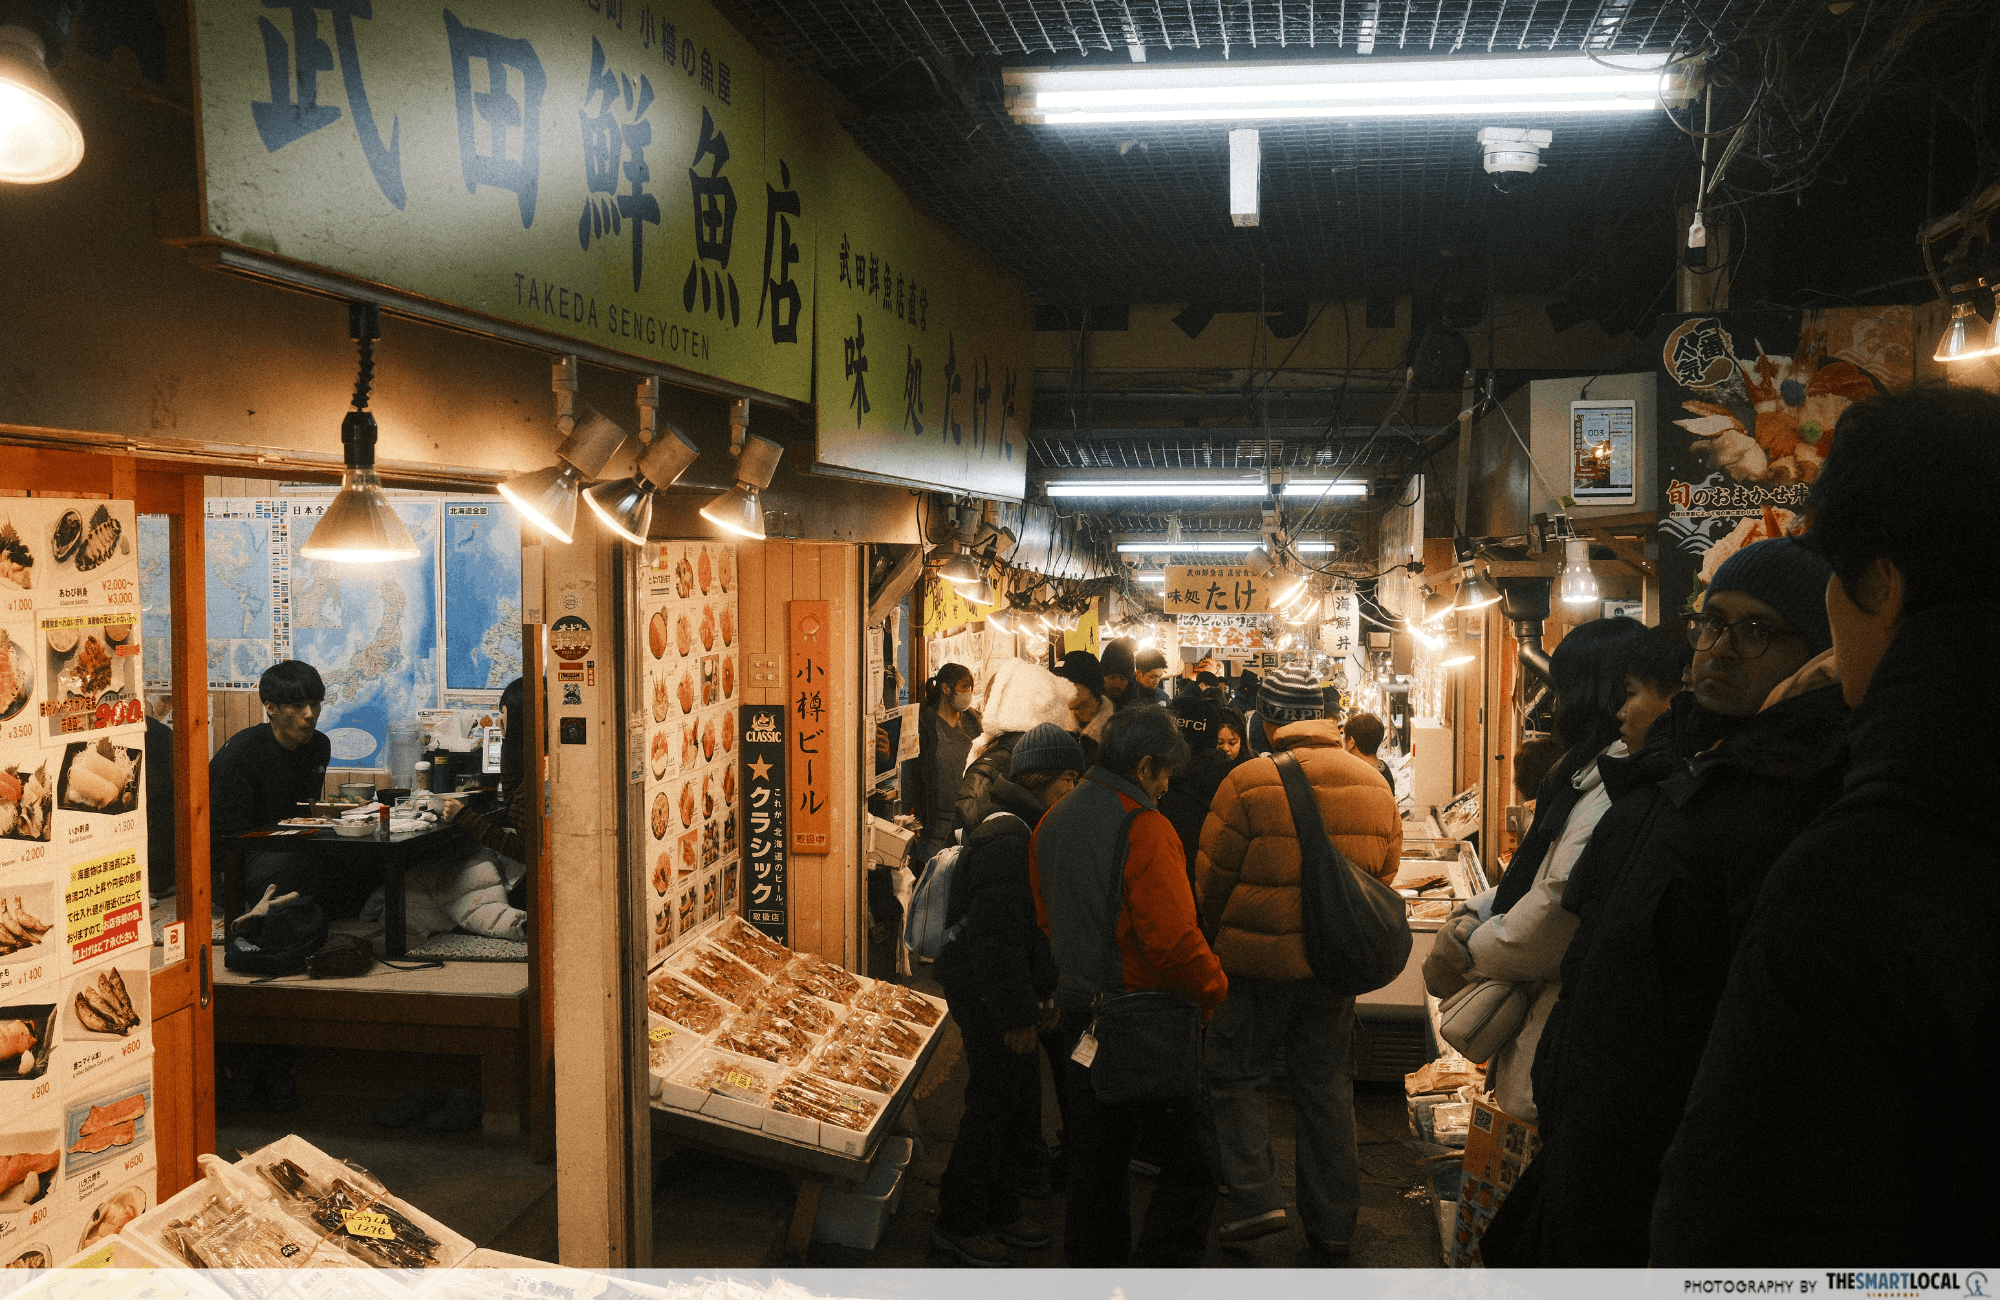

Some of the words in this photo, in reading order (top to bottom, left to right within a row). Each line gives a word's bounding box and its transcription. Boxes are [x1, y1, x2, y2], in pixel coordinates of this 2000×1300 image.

[252, 0, 802, 345] 武田鮮魚店
[514, 273, 597, 327] TAKEDA
[608, 308, 710, 361] SENGYOTEN
[293, 505, 326, 516] 日本全
[450, 507, 488, 515] 北海道全図
[1167, 588, 1200, 604] 味処
[1206, 579, 1270, 612] たけ
[745, 731, 782, 743] CLASSIC
[796, 658, 825, 815] 小樽ビール
[750, 786, 772, 904] クラシック
[773, 788, 784, 906] これが、北海道のビール。
[795, 834, 825, 845] 取扱中
[752, 912, 780, 922] 取扱店
[121, 1039, 141, 1057] ¥600
[124, 1152, 144, 1171] ¥600
